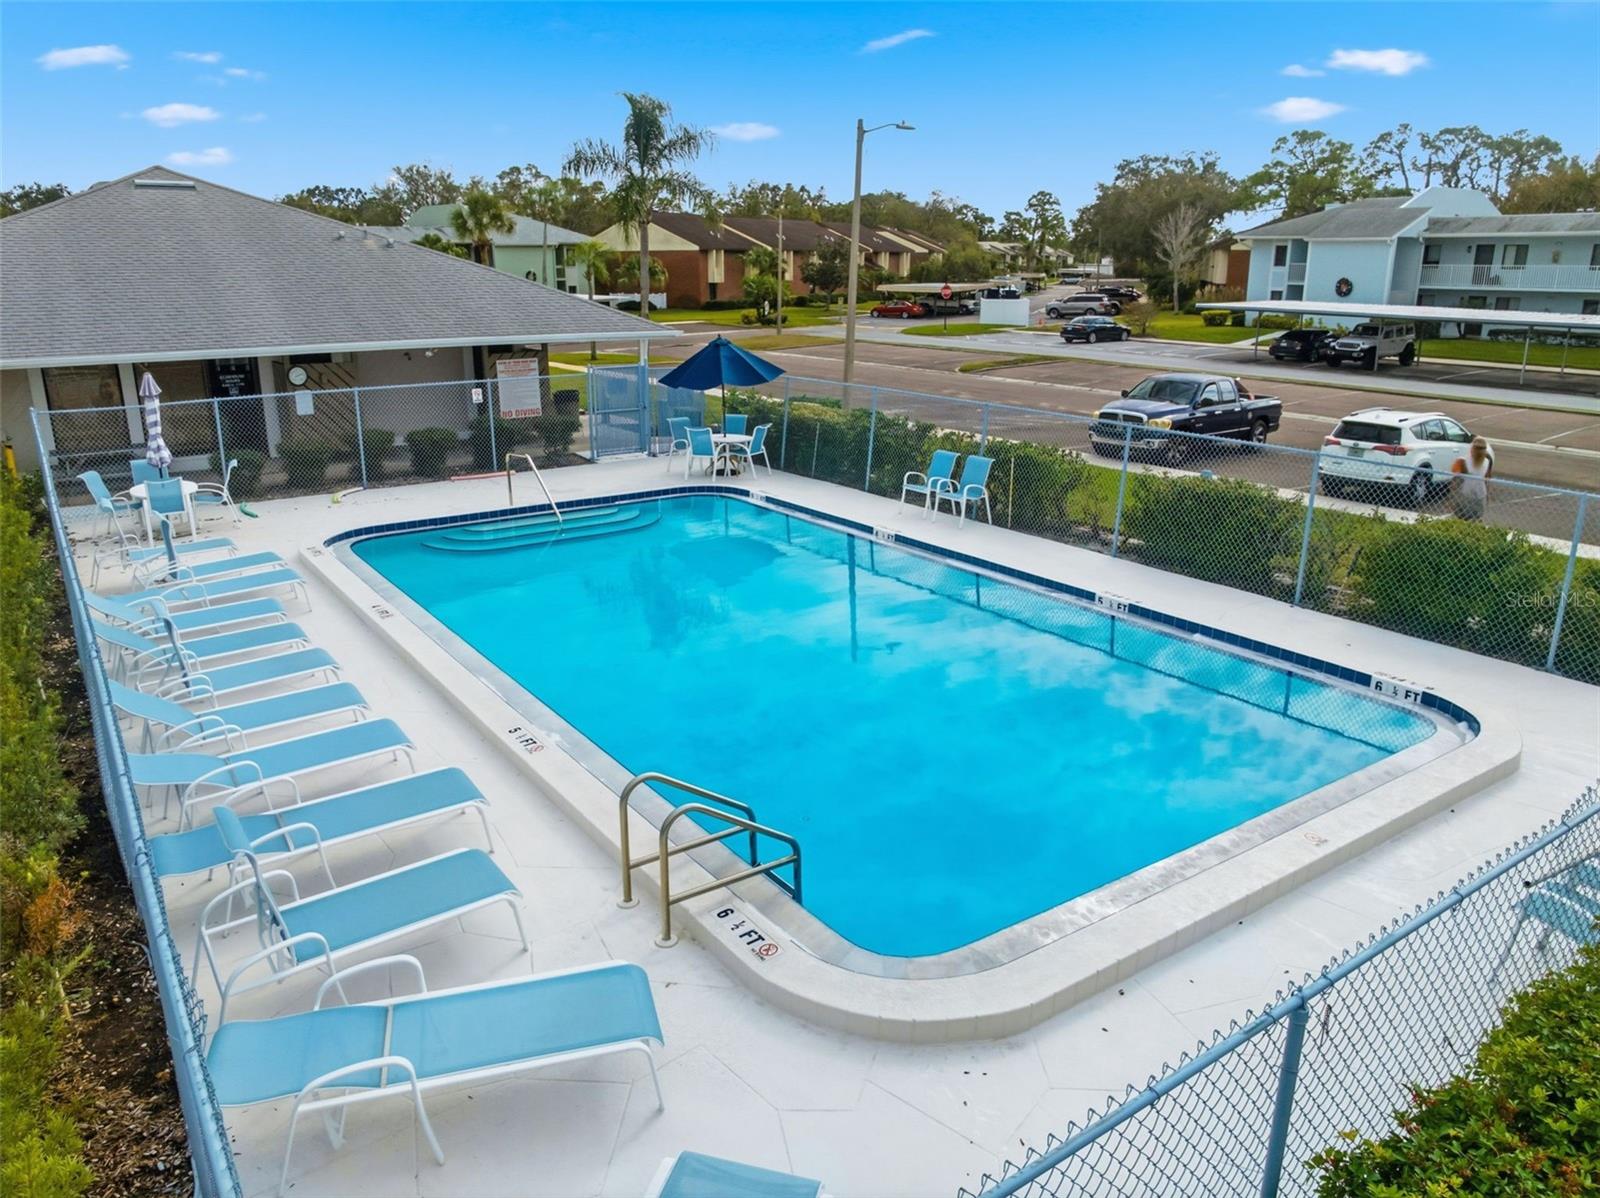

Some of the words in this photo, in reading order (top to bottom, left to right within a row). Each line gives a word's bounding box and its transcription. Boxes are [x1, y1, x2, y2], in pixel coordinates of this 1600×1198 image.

[502, 410, 513, 418] NO
[515, 408, 541, 417] DIVING
[1117, 602, 1128, 612] FT
[1374, 680, 1384, 692] 6
[1404, 689, 1421, 703] FT
[508, 726, 522, 734] 5
[519, 737, 538, 747] FT
[716, 908, 735, 919] 6
[738, 928, 766, 946] FT
